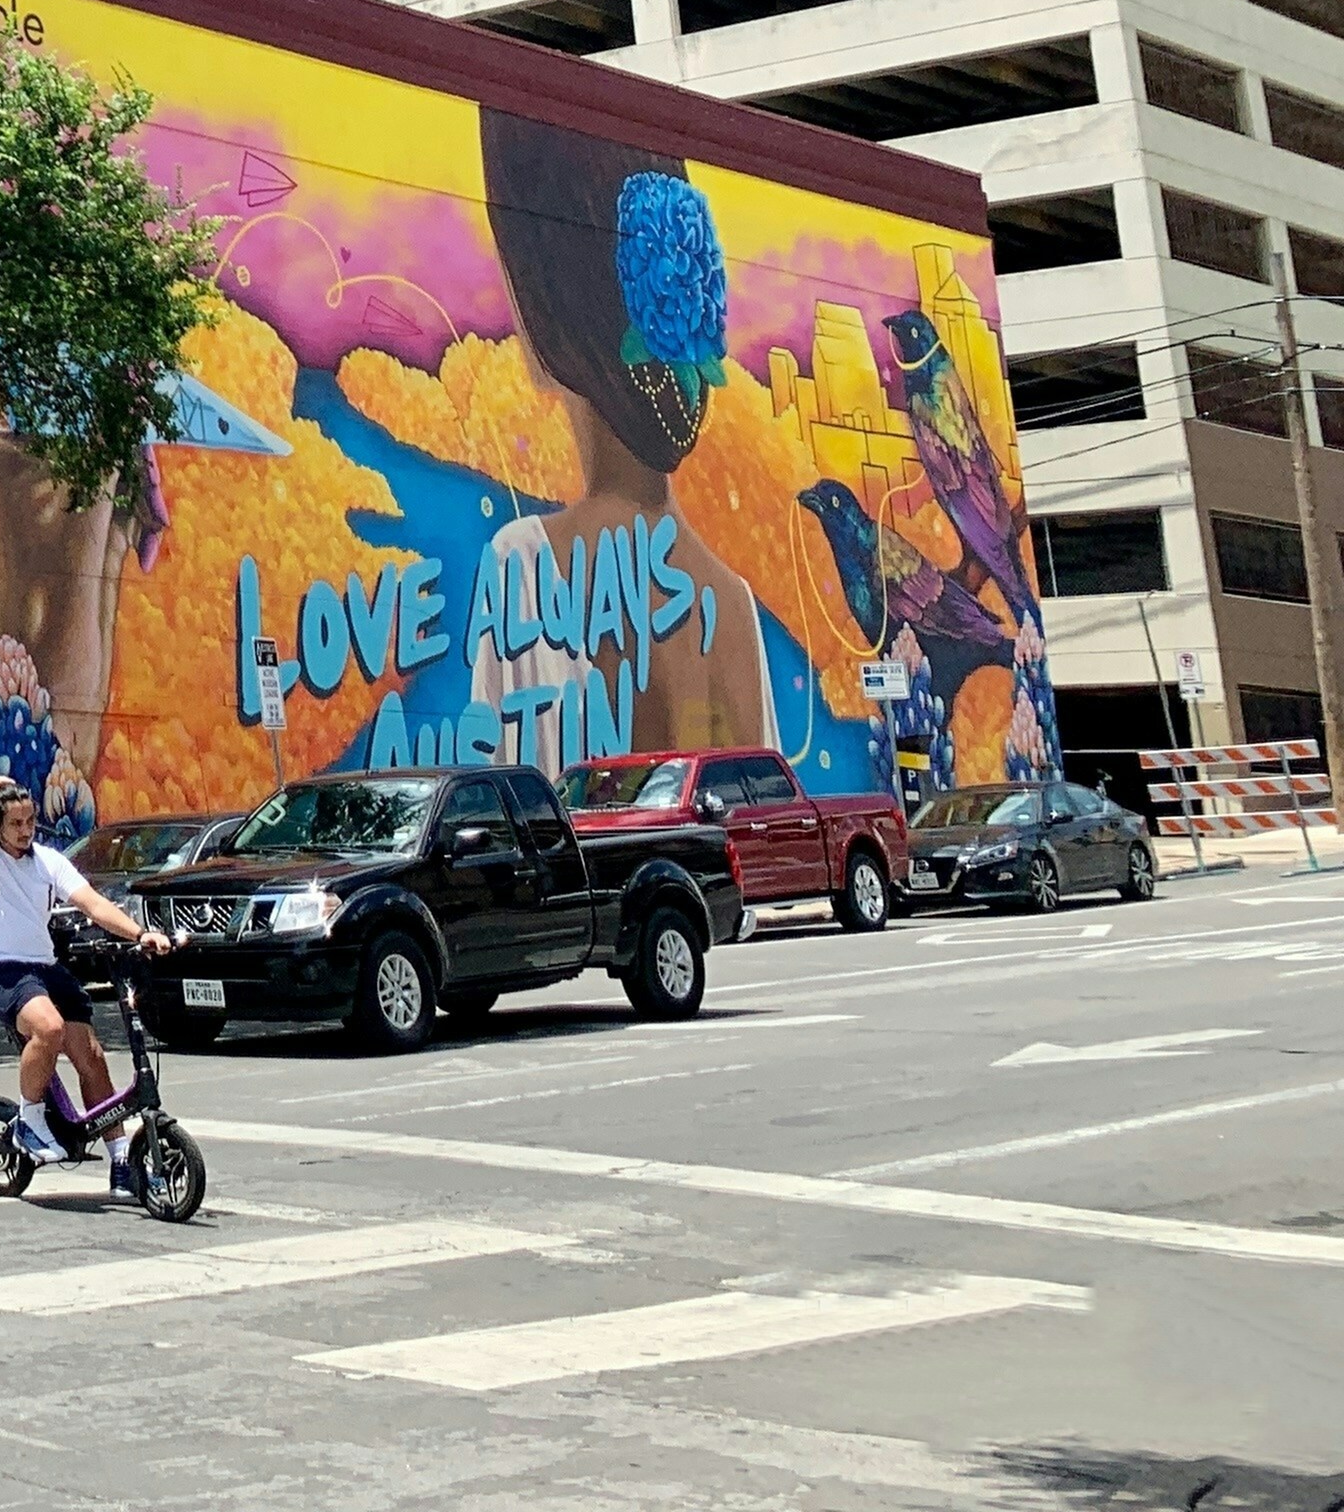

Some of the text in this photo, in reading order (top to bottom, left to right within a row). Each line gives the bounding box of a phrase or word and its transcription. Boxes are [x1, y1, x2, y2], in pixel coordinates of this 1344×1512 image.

[236, 554, 450, 725] LOVE
[465, 513, 718, 693] ALWAYS,
[94, 1102, 126, 1127] WHEELS
